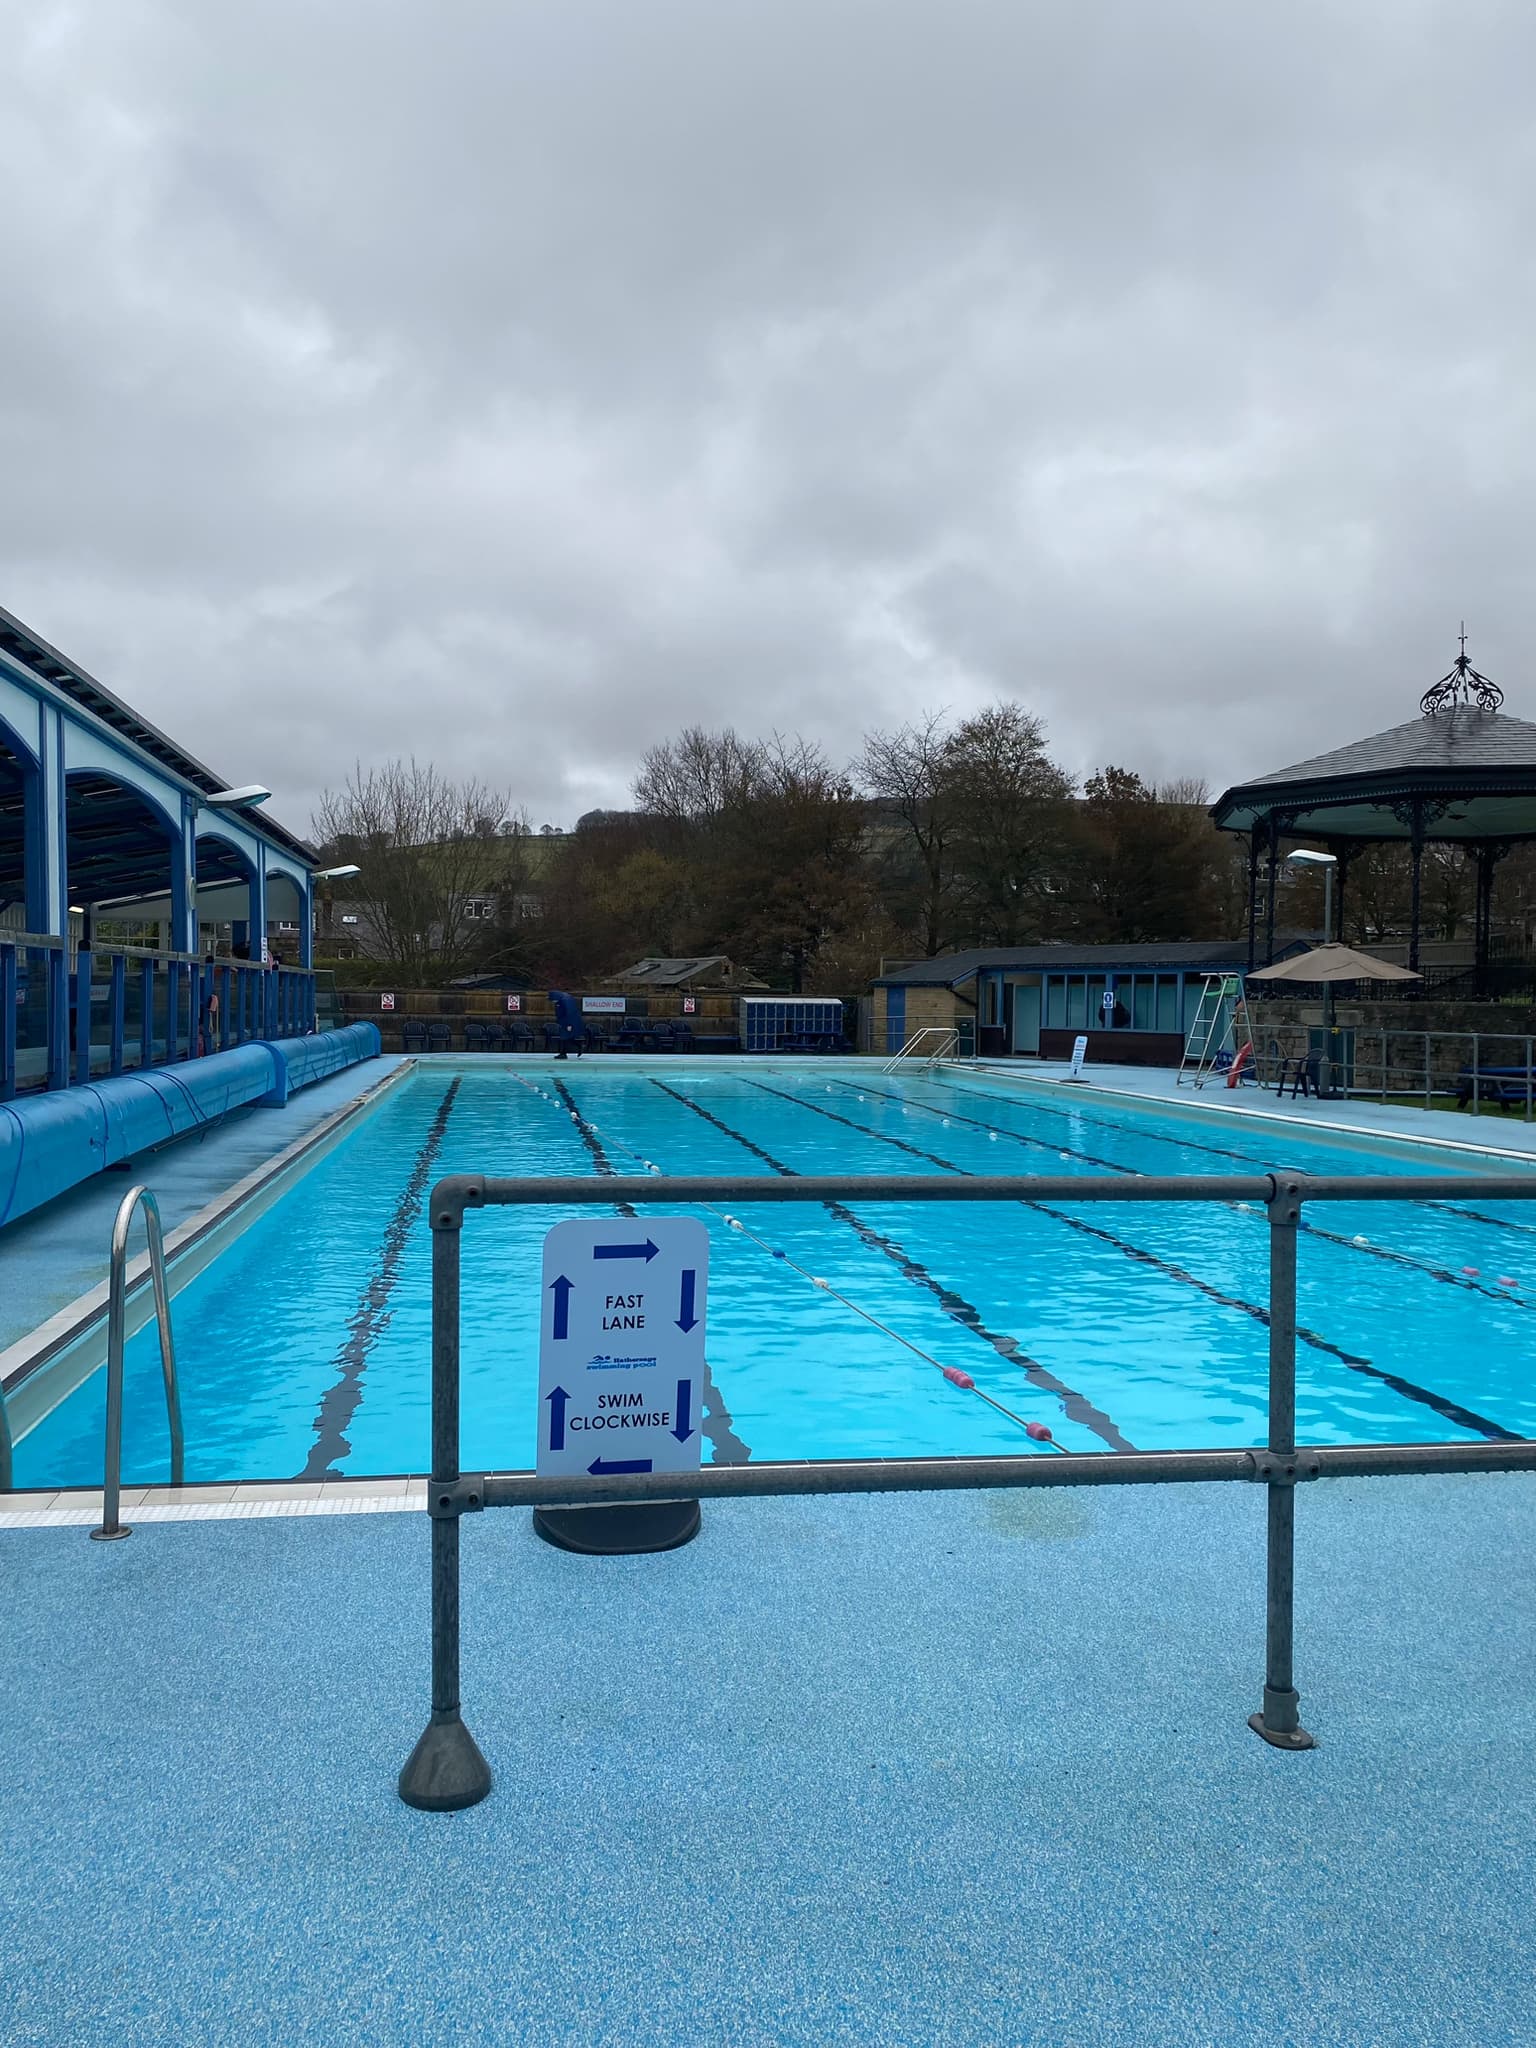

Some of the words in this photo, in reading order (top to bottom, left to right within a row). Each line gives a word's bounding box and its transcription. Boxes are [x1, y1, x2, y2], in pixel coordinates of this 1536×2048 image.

[584, 1000, 611, 1009] SHALLOW
[612, 1000, 624, 1008] END
[605, 1294, 644, 1309] FAST
[602, 1315, 645, 1330] LANE
[586, 1362, 631, 1370] swimming
[632, 1361, 657, 1369] pool
[597, 1393, 643, 1409] SWIM
[569, 1412, 670, 1431] CLOCKWISE
